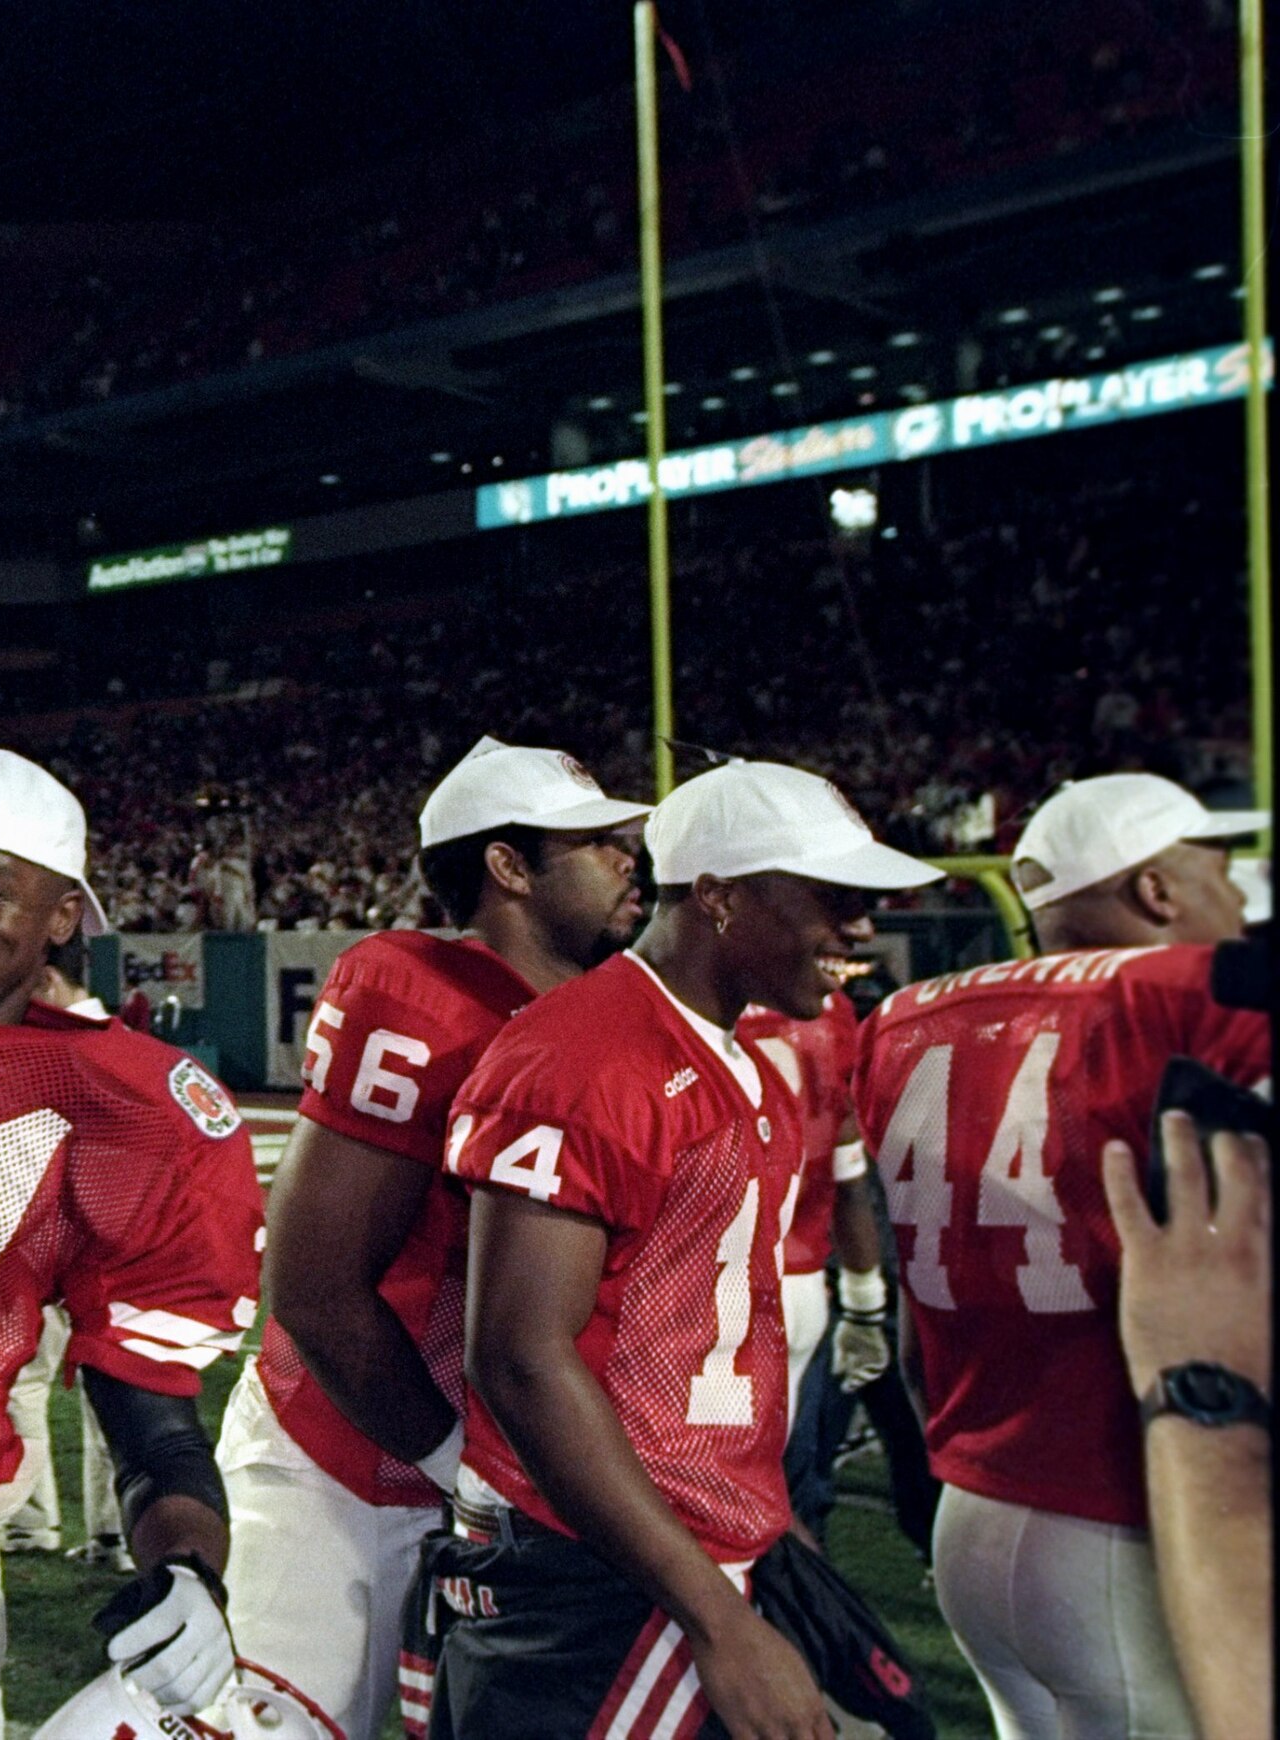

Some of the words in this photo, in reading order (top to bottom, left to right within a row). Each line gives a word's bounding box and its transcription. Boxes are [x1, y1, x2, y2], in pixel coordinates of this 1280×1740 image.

[123, 950, 197, 985] FedEx
[664, 1066, 700, 1099] adidas
[448, 1113, 565, 1202] 14
[877, 1032, 1097, 1313] 44
